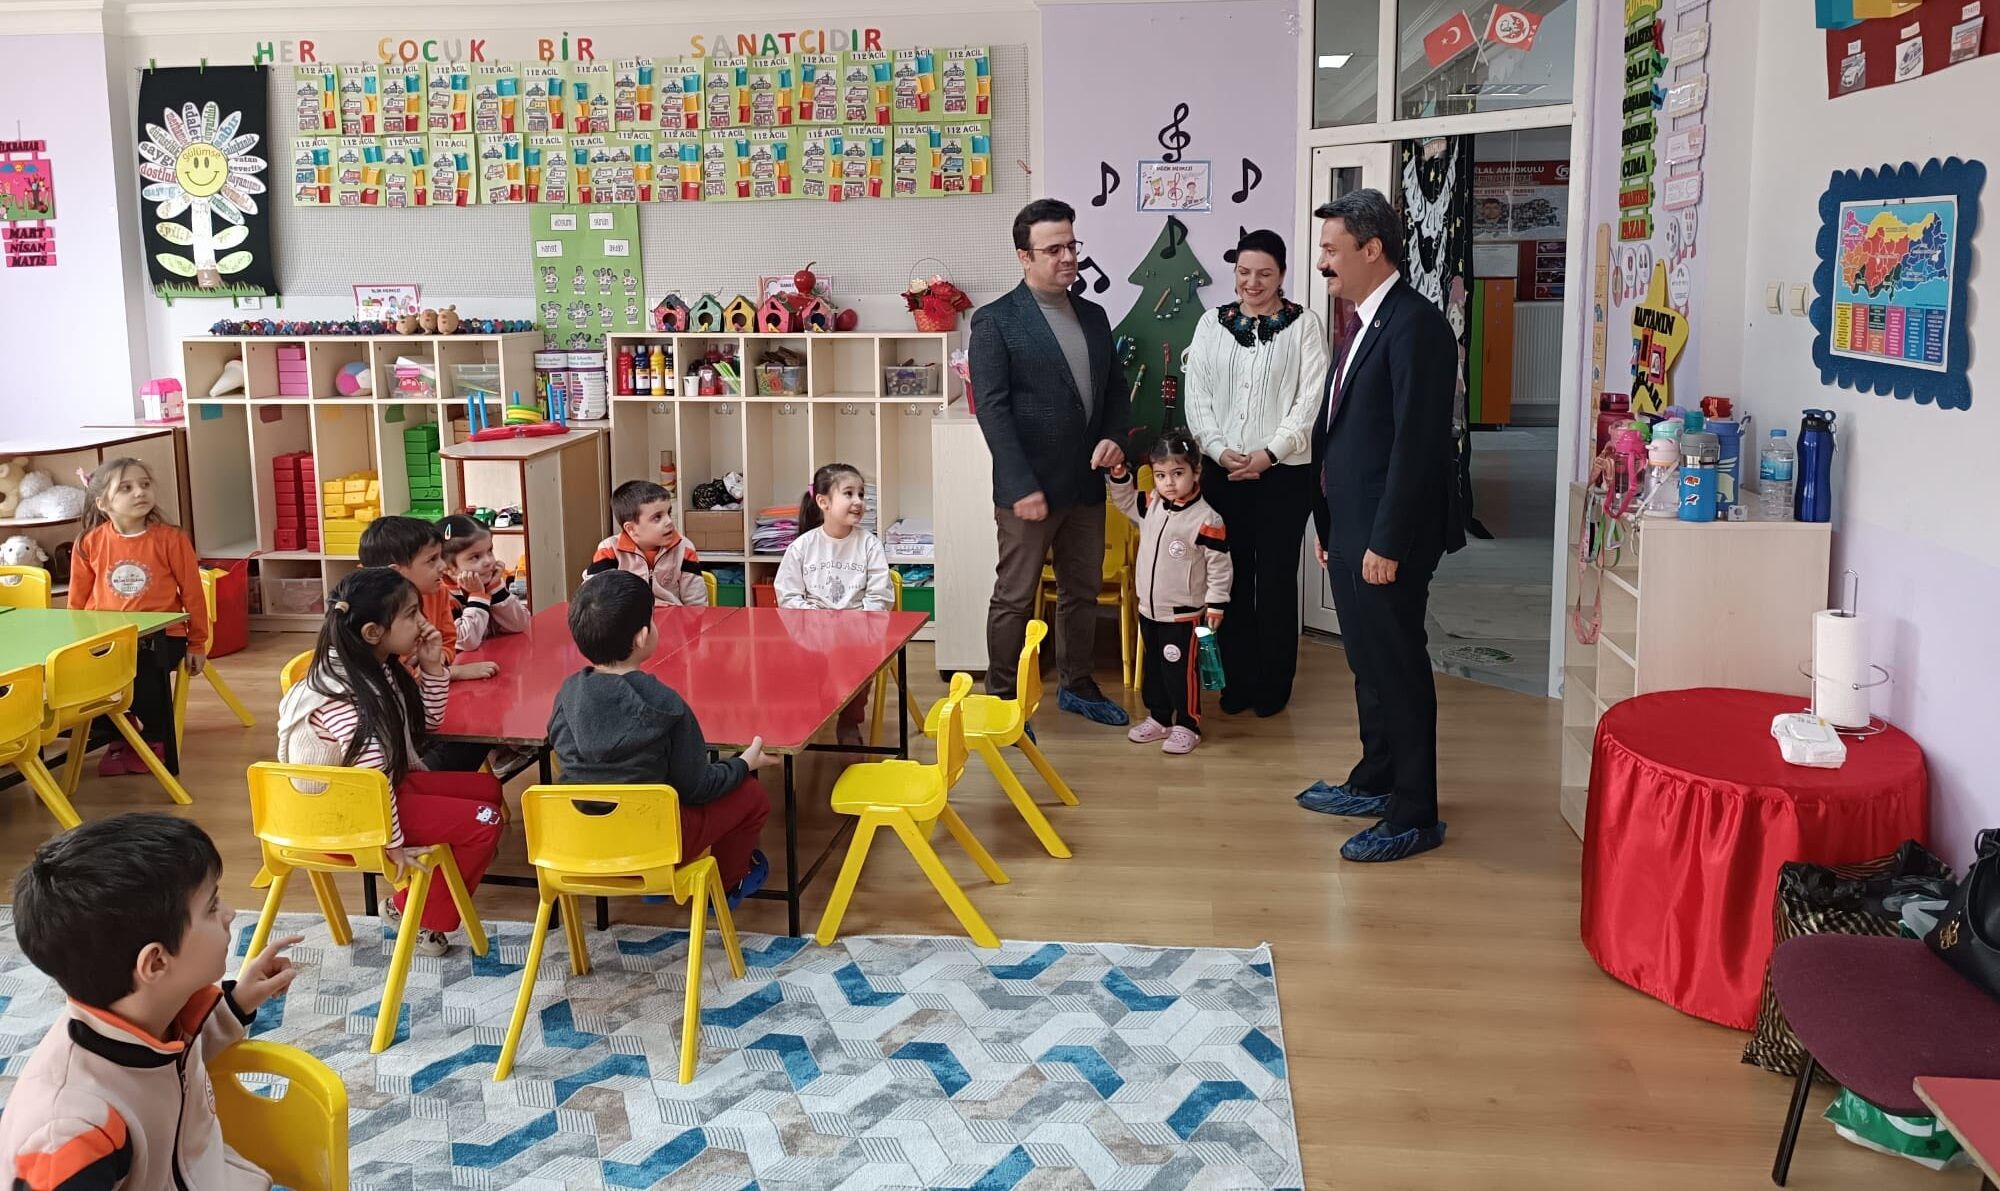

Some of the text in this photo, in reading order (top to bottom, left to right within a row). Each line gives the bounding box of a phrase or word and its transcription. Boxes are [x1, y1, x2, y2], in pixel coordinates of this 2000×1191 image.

[256, 40, 316, 63] HER
[378, 37, 486, 64] ÇOCUK
[538, 31, 595, 62] BİR
[898, 51, 913, 59] 112
[948, 51, 963, 59] 112
[619, 61, 634, 69] 112
[1626, 58, 1650, 83] SALI
[184, 103, 200, 141] adalet
[214, 116, 239, 147] sabır
[808, 131, 823, 139] 112
[946, 126, 961, 134] 112
[296, 140, 310, 148] 112
[342, 138, 357, 146] 112
[570, 139, 585, 147] 112
[140, 142, 175, 166] saygı
[183, 147, 221, 162] gülümse
[1622, 154, 1647, 178] CUMA
[140, 164, 177, 183] dostluk
[9, 228, 45, 239] MART
[10, 241, 47, 253] NİSAN
[12, 255, 47, 267] MAYIS
[1633, 306, 1675, 336] HAFTANIN
